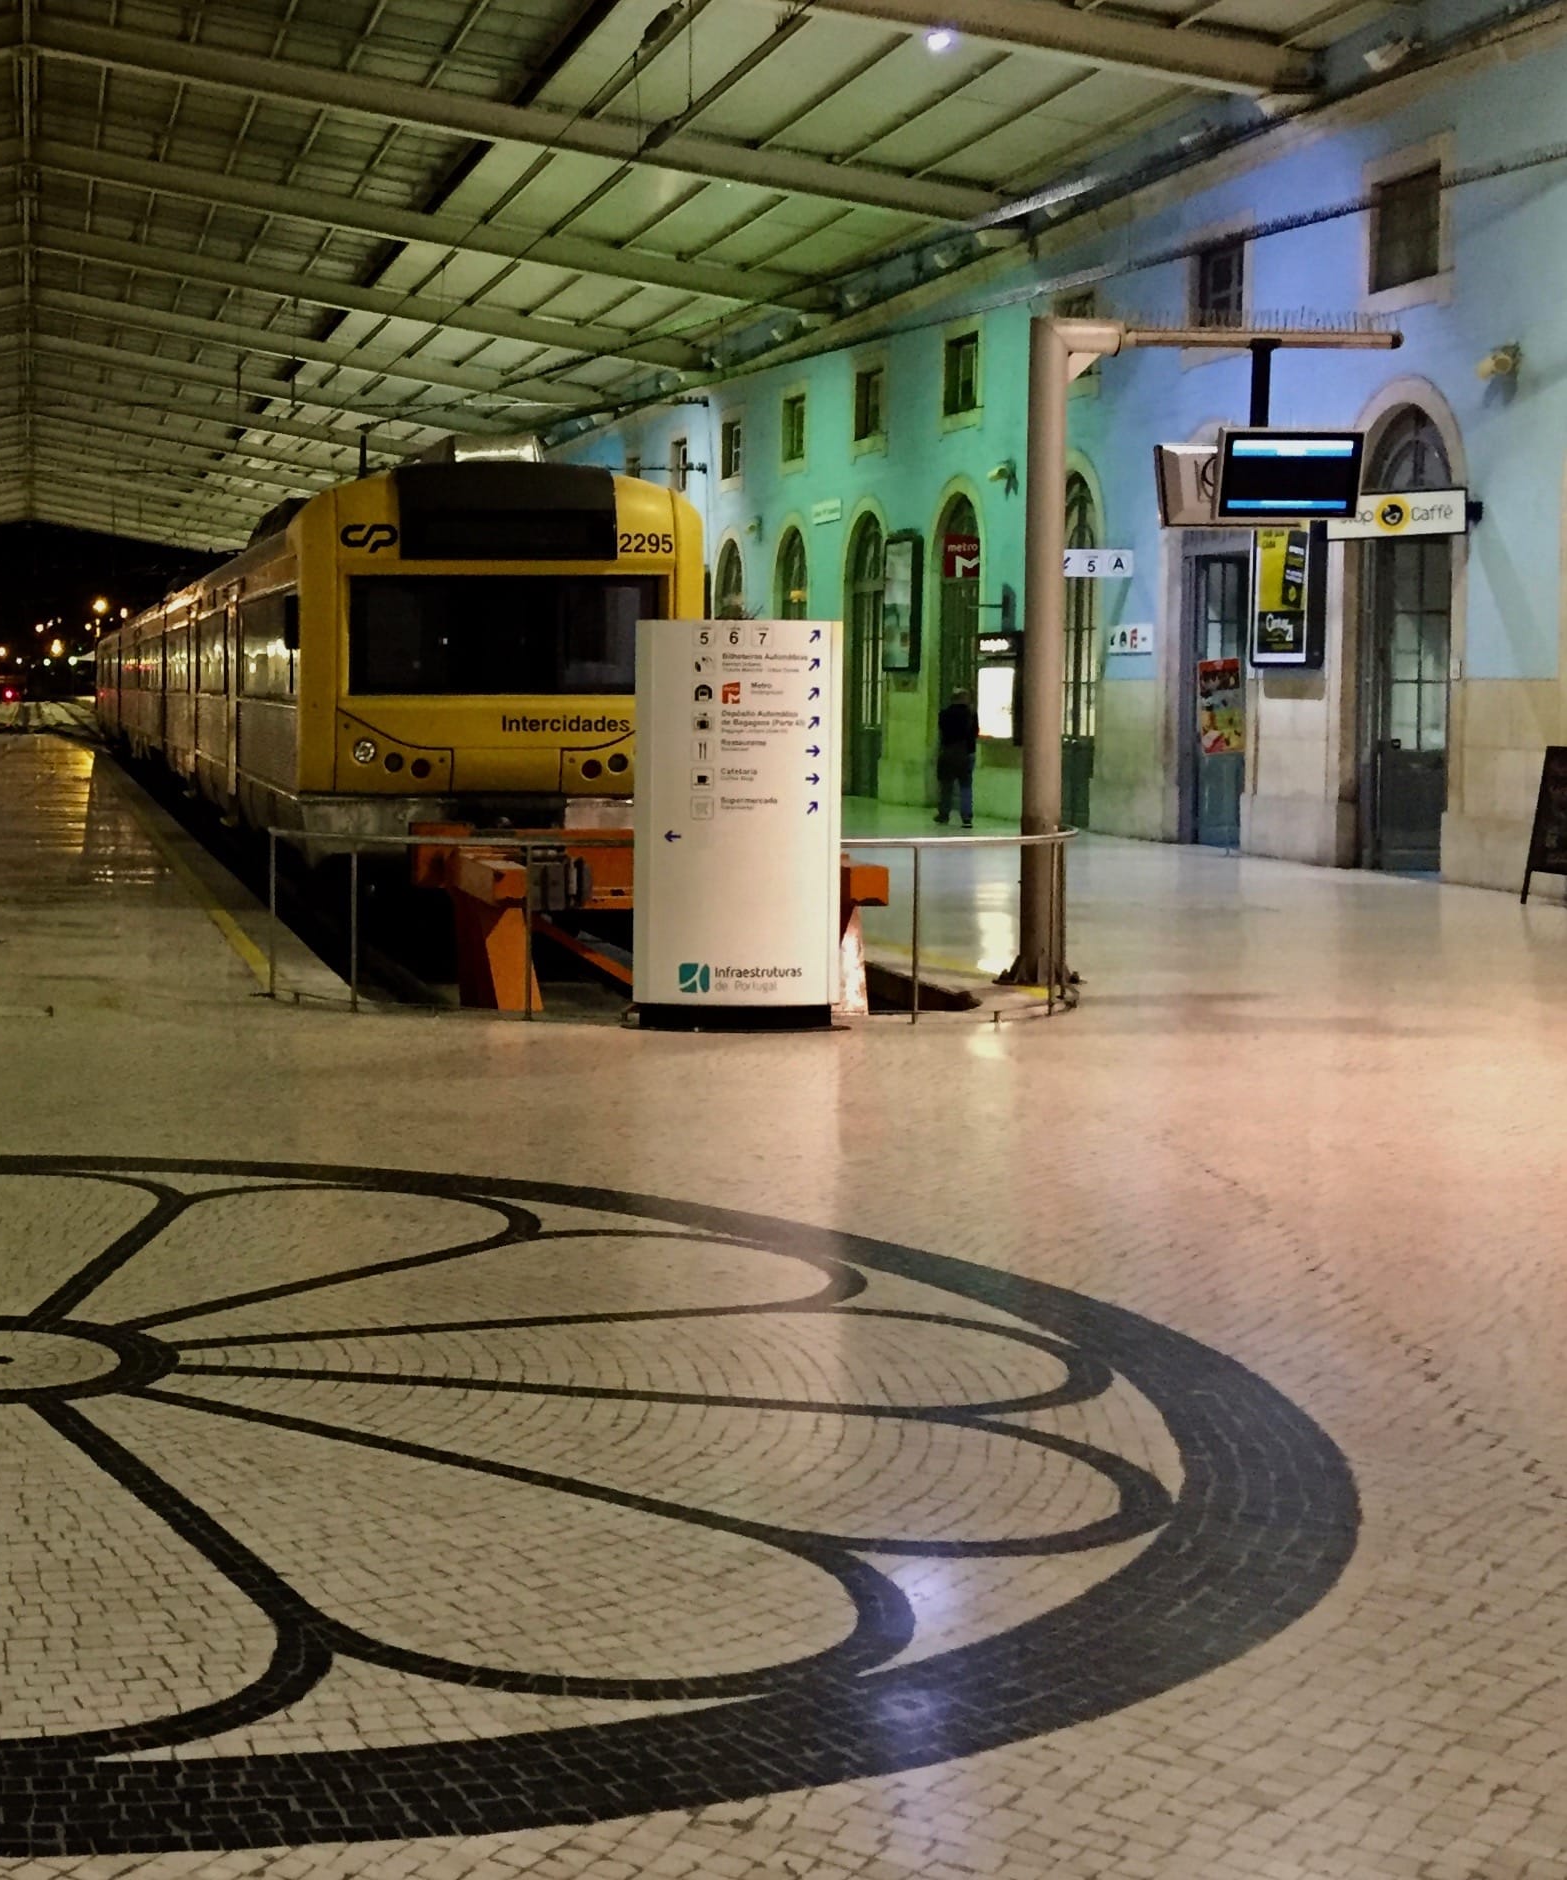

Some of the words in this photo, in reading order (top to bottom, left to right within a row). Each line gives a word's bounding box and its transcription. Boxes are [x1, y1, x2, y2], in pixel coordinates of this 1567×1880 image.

[619, 534, 674, 554] 2295
[947, 542, 978, 552] metro
[1087, 560, 1096, 573] 5
[1113, 557, 1124, 570] A
[700, 632, 709, 645] 5
[729, 631, 739, 645] 6
[759, 632, 767, 645] 7
[501, 715, 630, 733] Intercidades
[715, 966, 802, 979] Infraestruturas
[715, 980, 728, 991] de
[734, 980, 778, 993] Portugal
